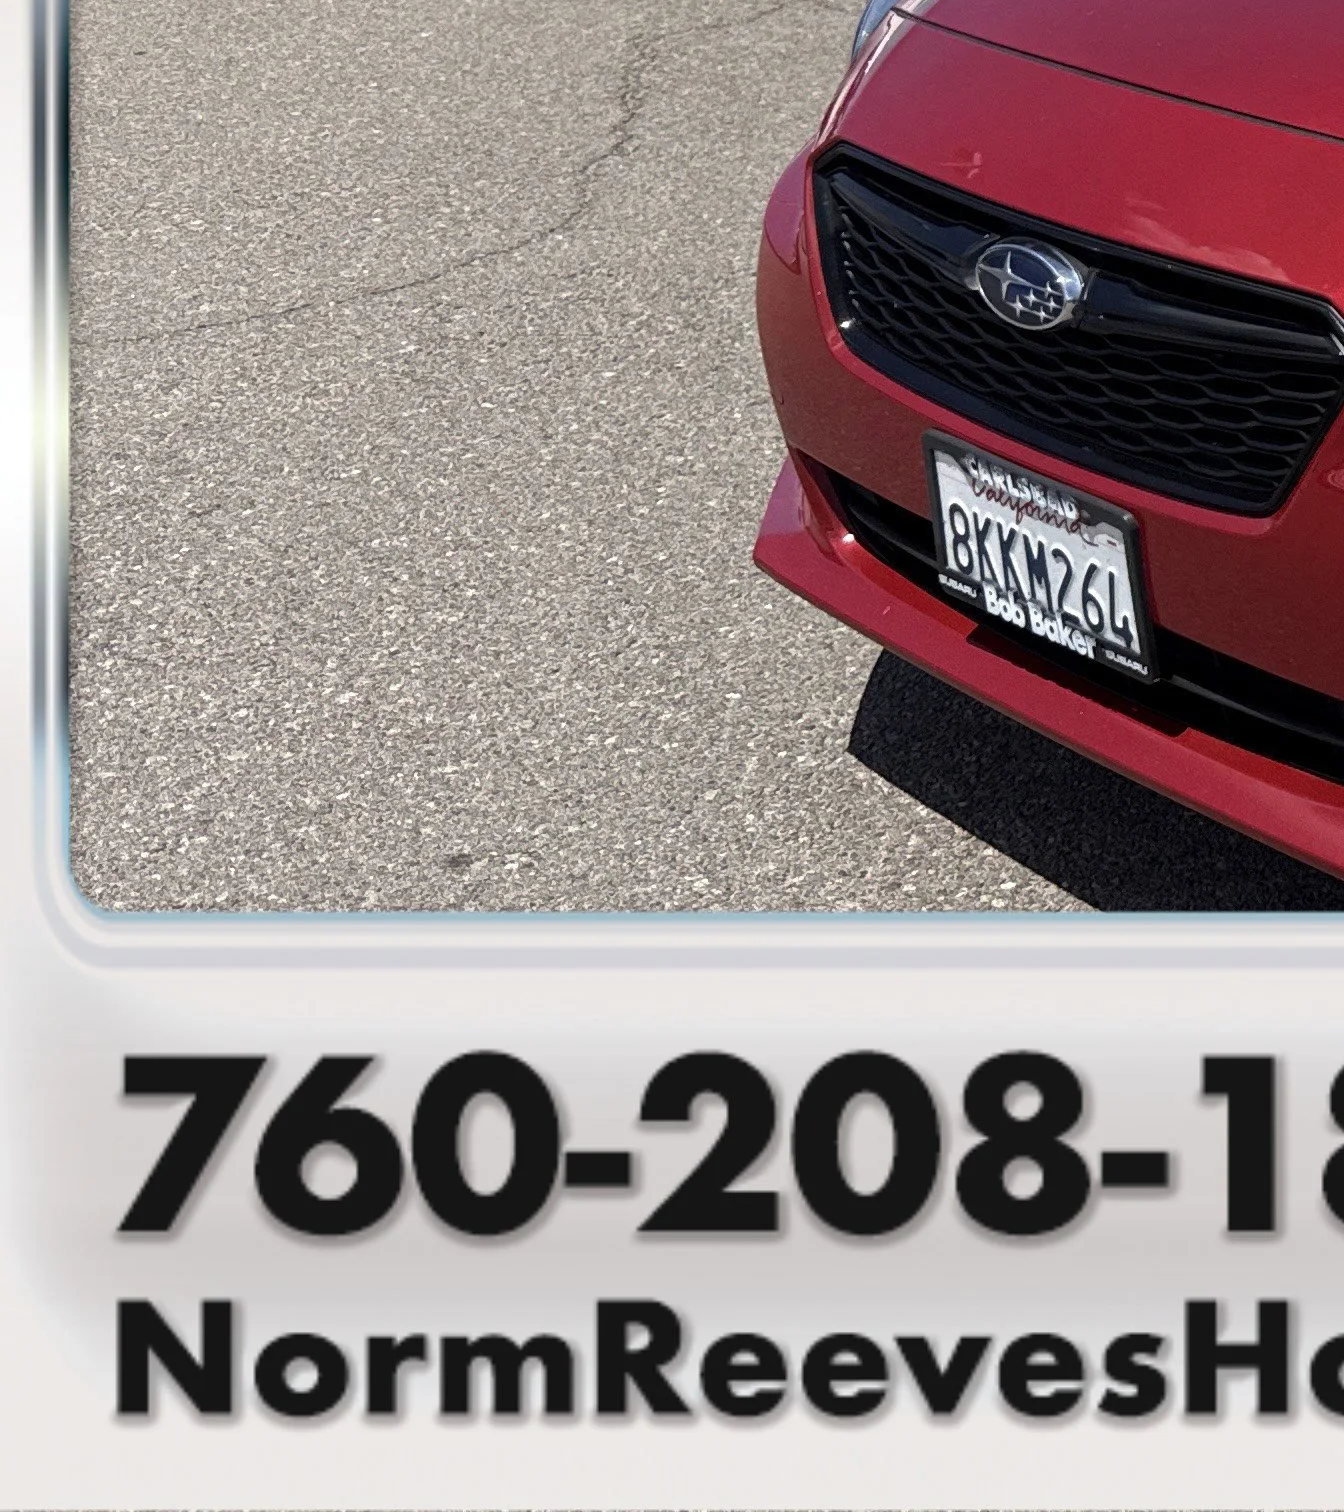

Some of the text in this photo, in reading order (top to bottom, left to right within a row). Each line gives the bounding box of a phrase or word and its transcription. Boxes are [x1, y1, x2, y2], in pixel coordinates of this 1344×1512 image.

[948, 501, 1135, 649] 8KKM264
[981, 581, 1096, 660] Bob Baker
